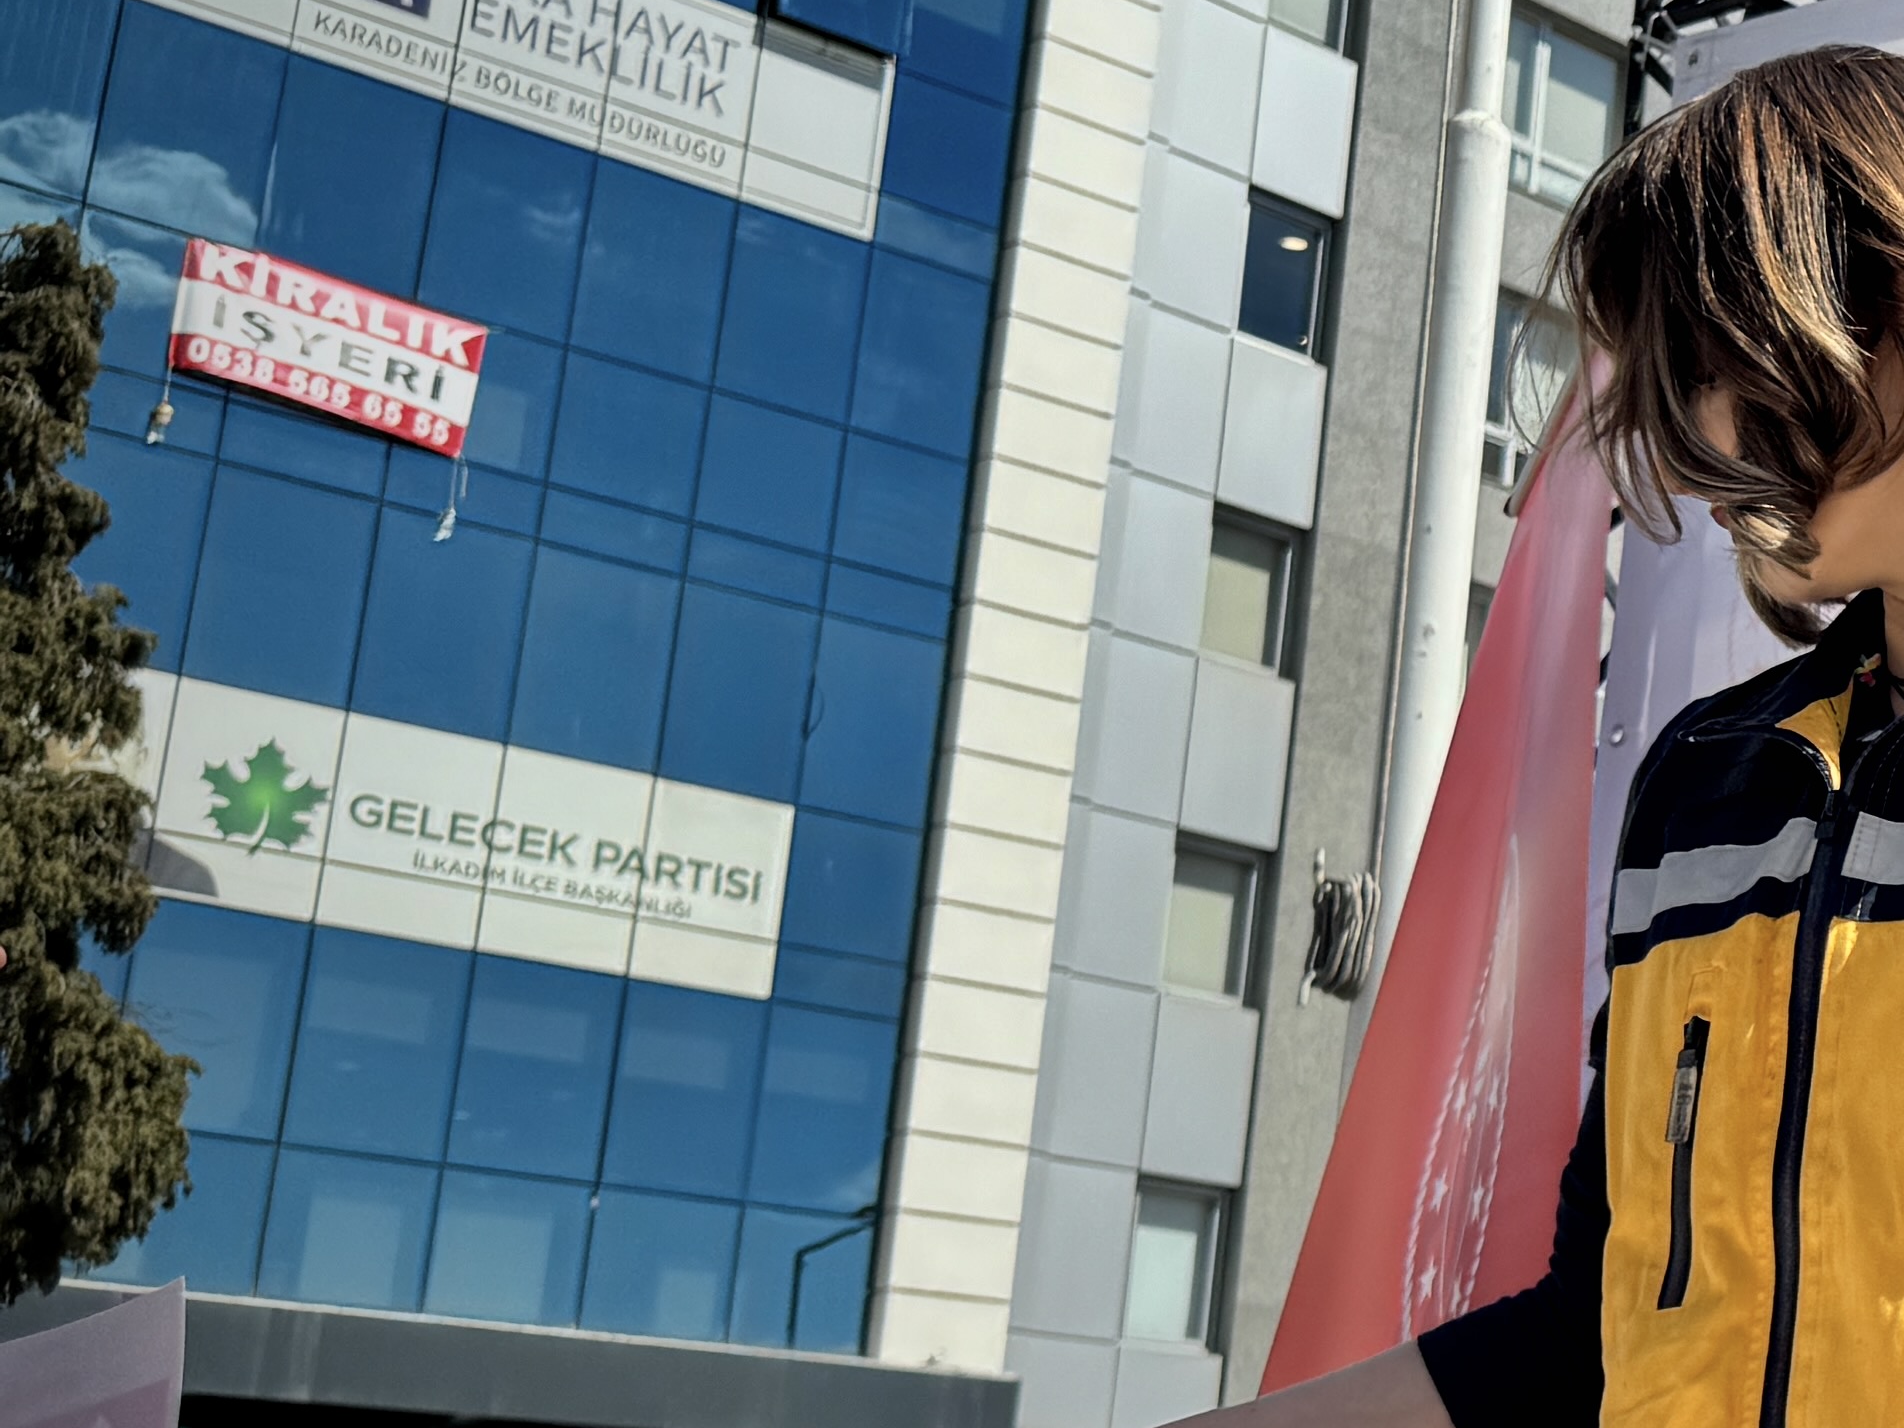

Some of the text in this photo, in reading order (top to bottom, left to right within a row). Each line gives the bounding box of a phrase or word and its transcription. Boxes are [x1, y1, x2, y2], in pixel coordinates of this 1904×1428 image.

[201, 244, 477, 369] KİRALIK
[213, 294, 446, 402] İŞYERİ
[186, 337, 276, 386] 0538
[349, 793, 581, 867] GELECEK
